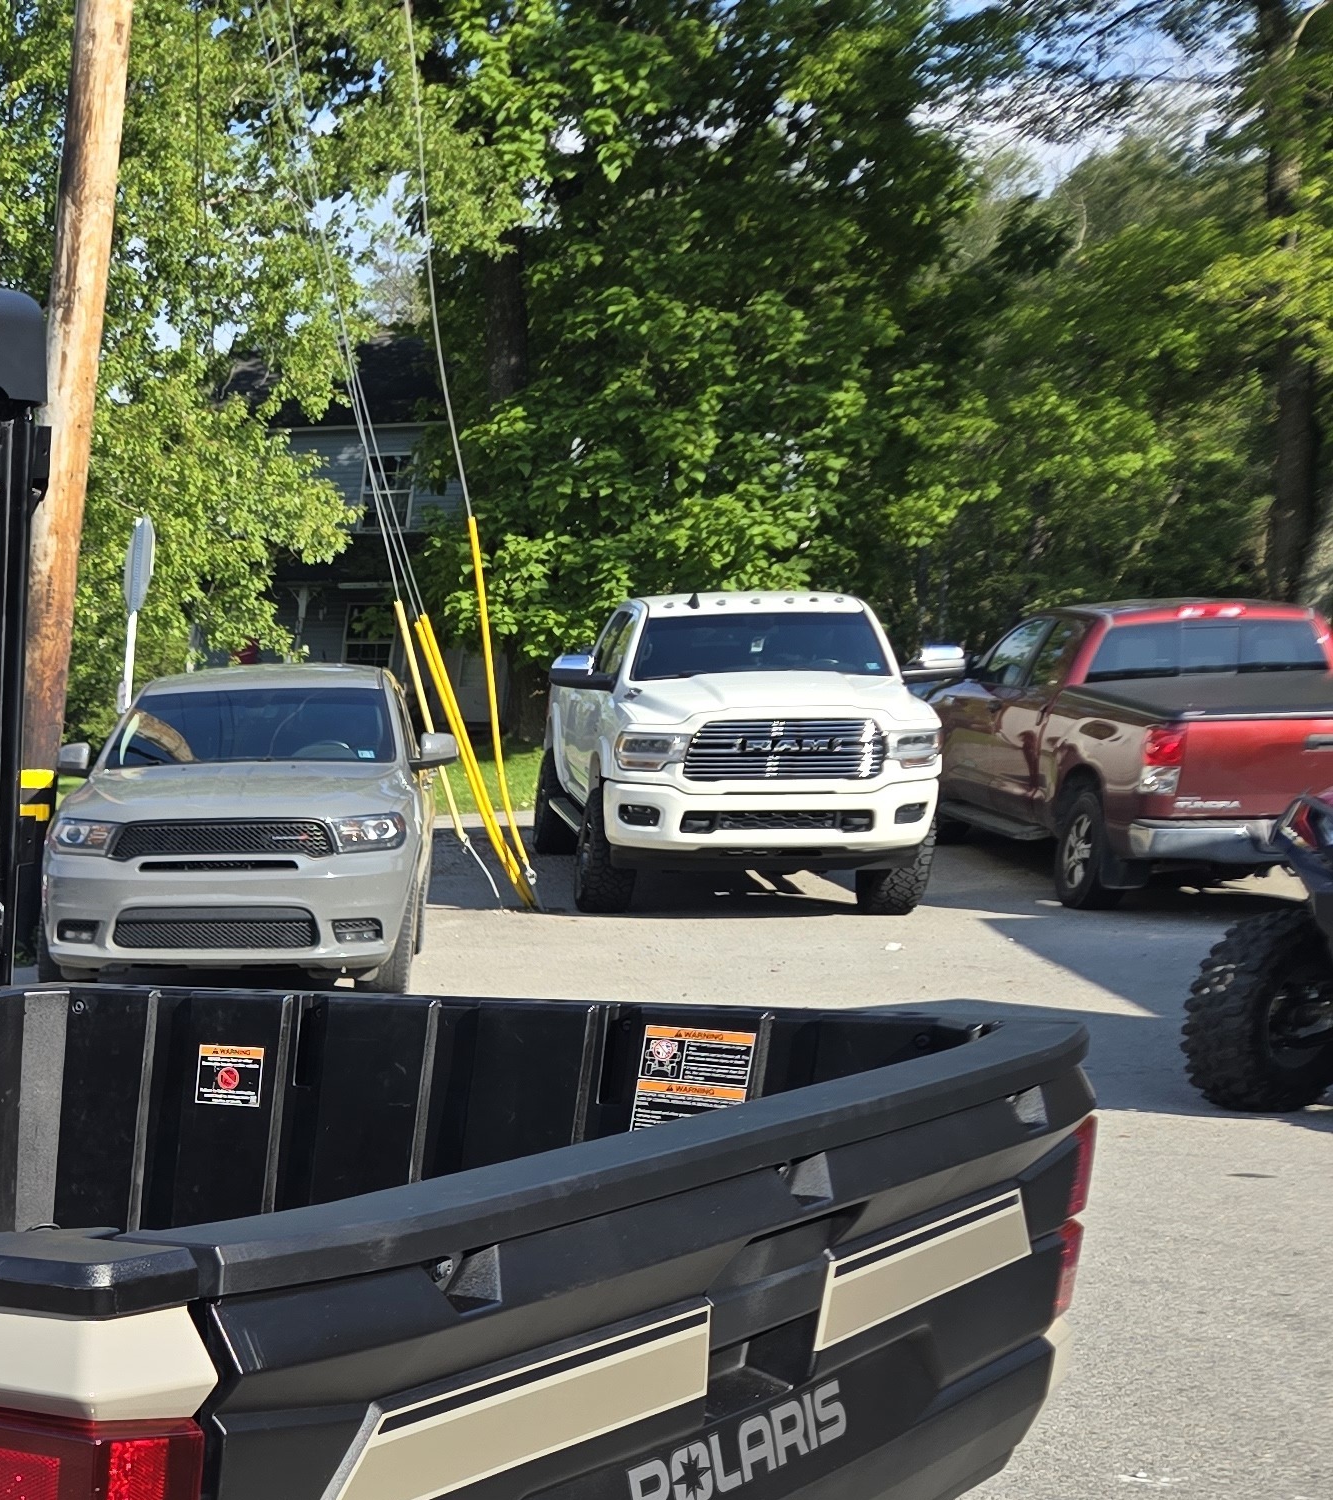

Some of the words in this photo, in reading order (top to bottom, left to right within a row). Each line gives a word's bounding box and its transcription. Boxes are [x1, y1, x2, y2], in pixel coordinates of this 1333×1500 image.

[743, 737, 831, 752] RAM
[684, 1031, 724, 1041] WARNING
[219, 1048, 251, 1056] WARNING
[675, 1086, 715, 1096] WARNING
